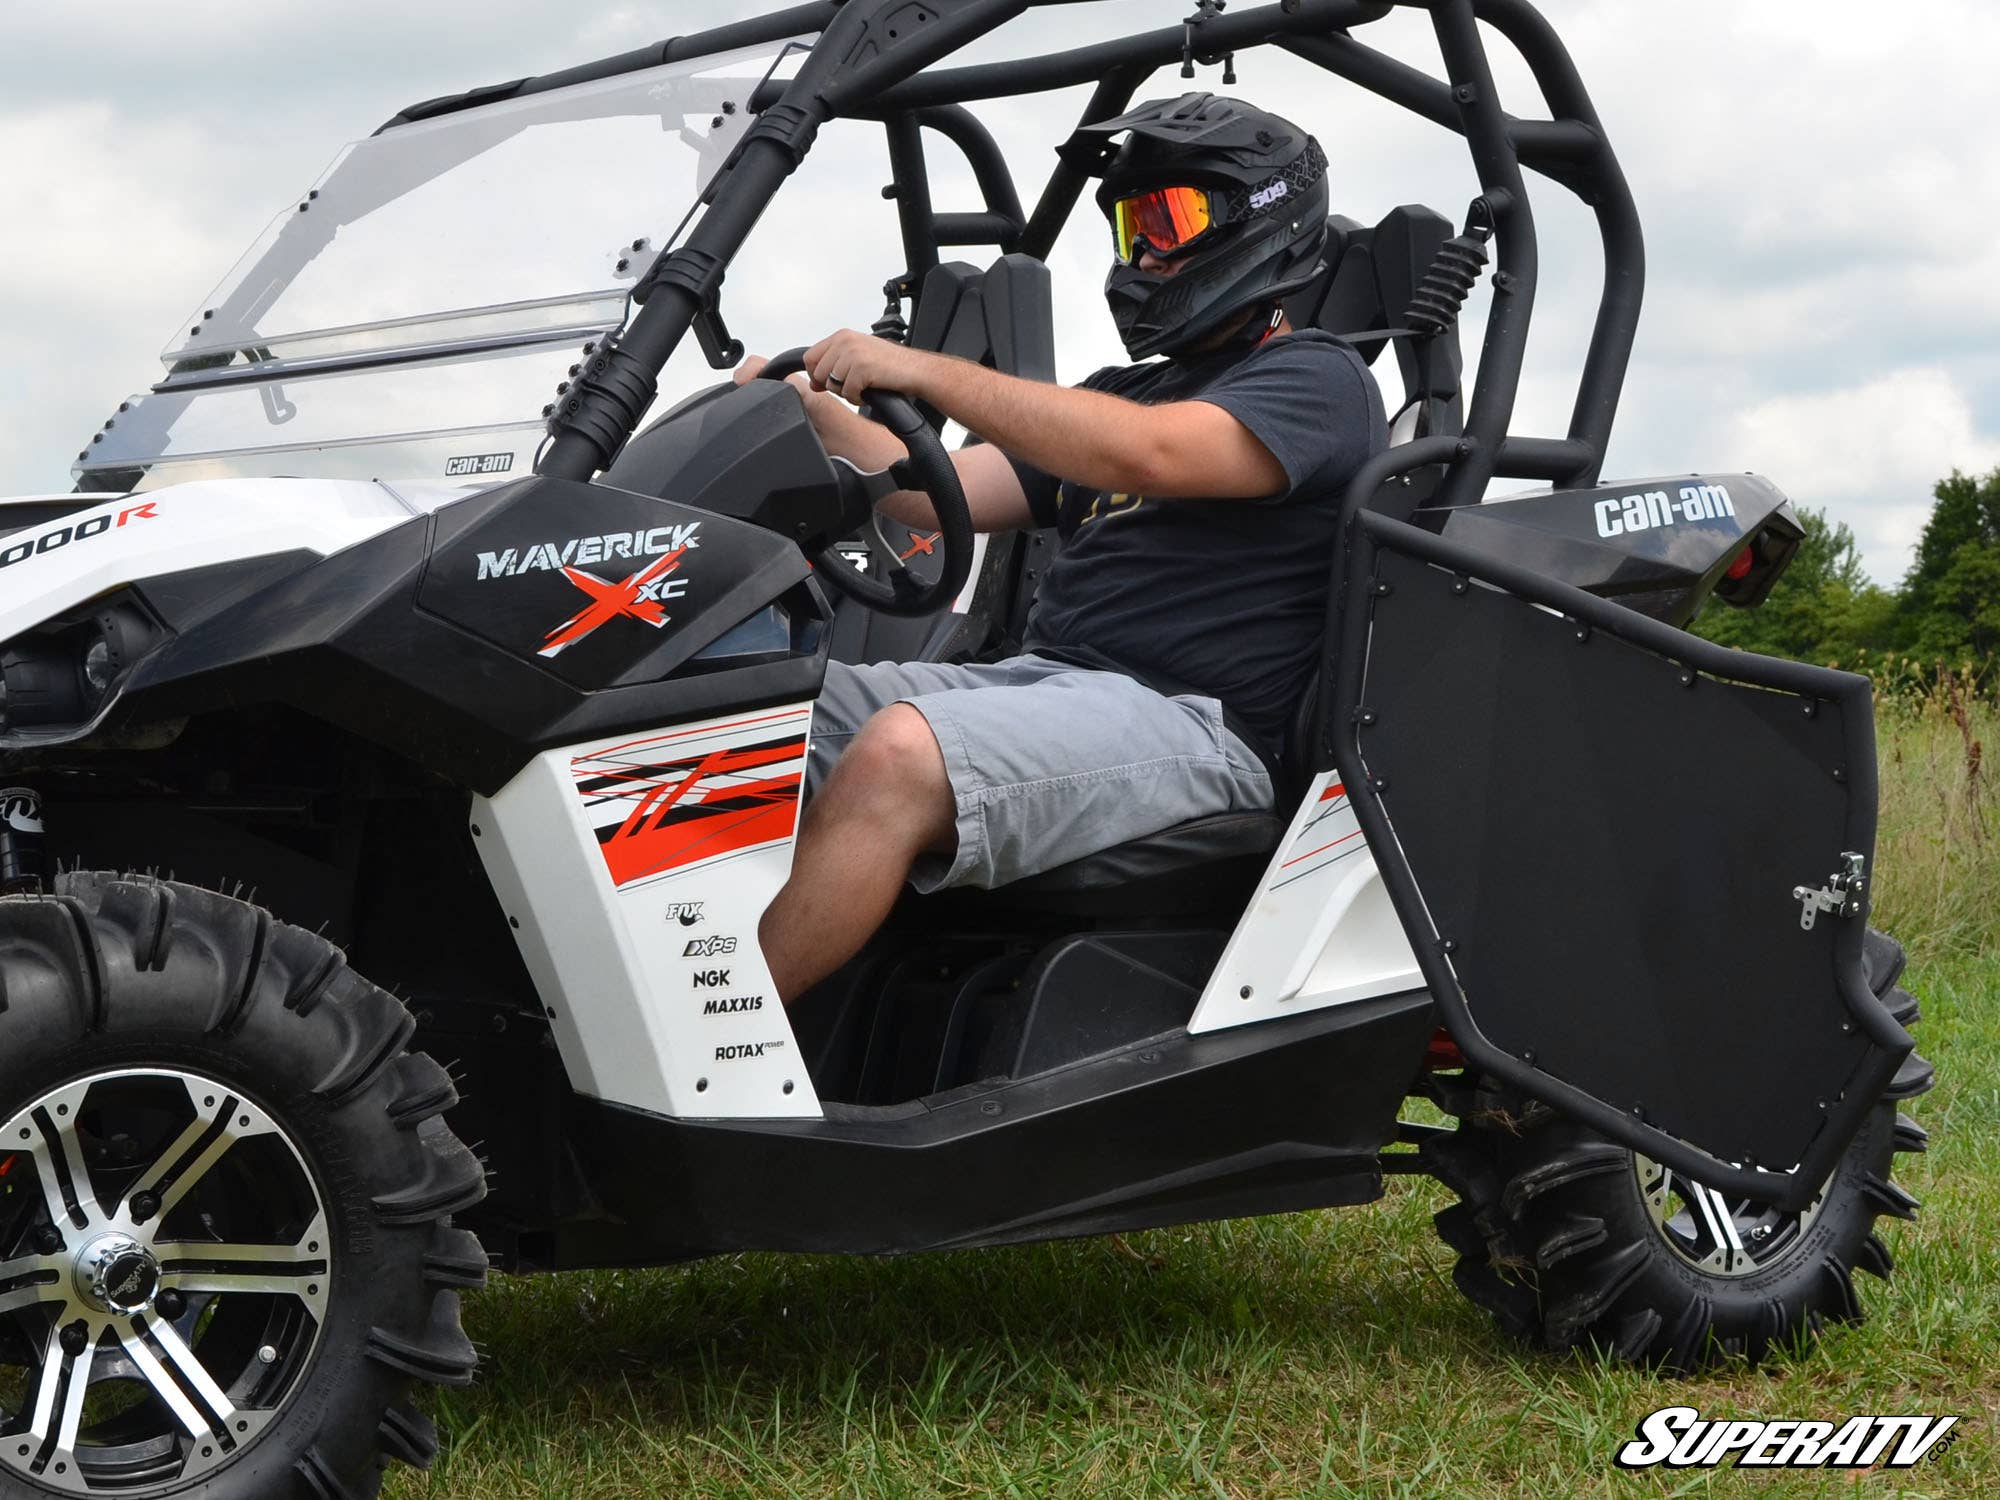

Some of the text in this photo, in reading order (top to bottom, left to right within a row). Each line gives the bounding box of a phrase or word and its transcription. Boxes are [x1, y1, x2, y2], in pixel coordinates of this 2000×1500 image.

[1249, 180, 1287, 208] 509
[446, 454, 512, 475] can-am
[1594, 484, 1735, 538] can-am
[476, 521, 701, 580] MAVERICK
[634, 578, 689, 604] XC
[666, 902, 704, 926] FOX
[698, 935, 737, 957] XPS
[693, 969, 730, 988] NGK
[703, 996, 763, 1015] MAXXIS
[715, 1042, 764, 1060] ROTAX
